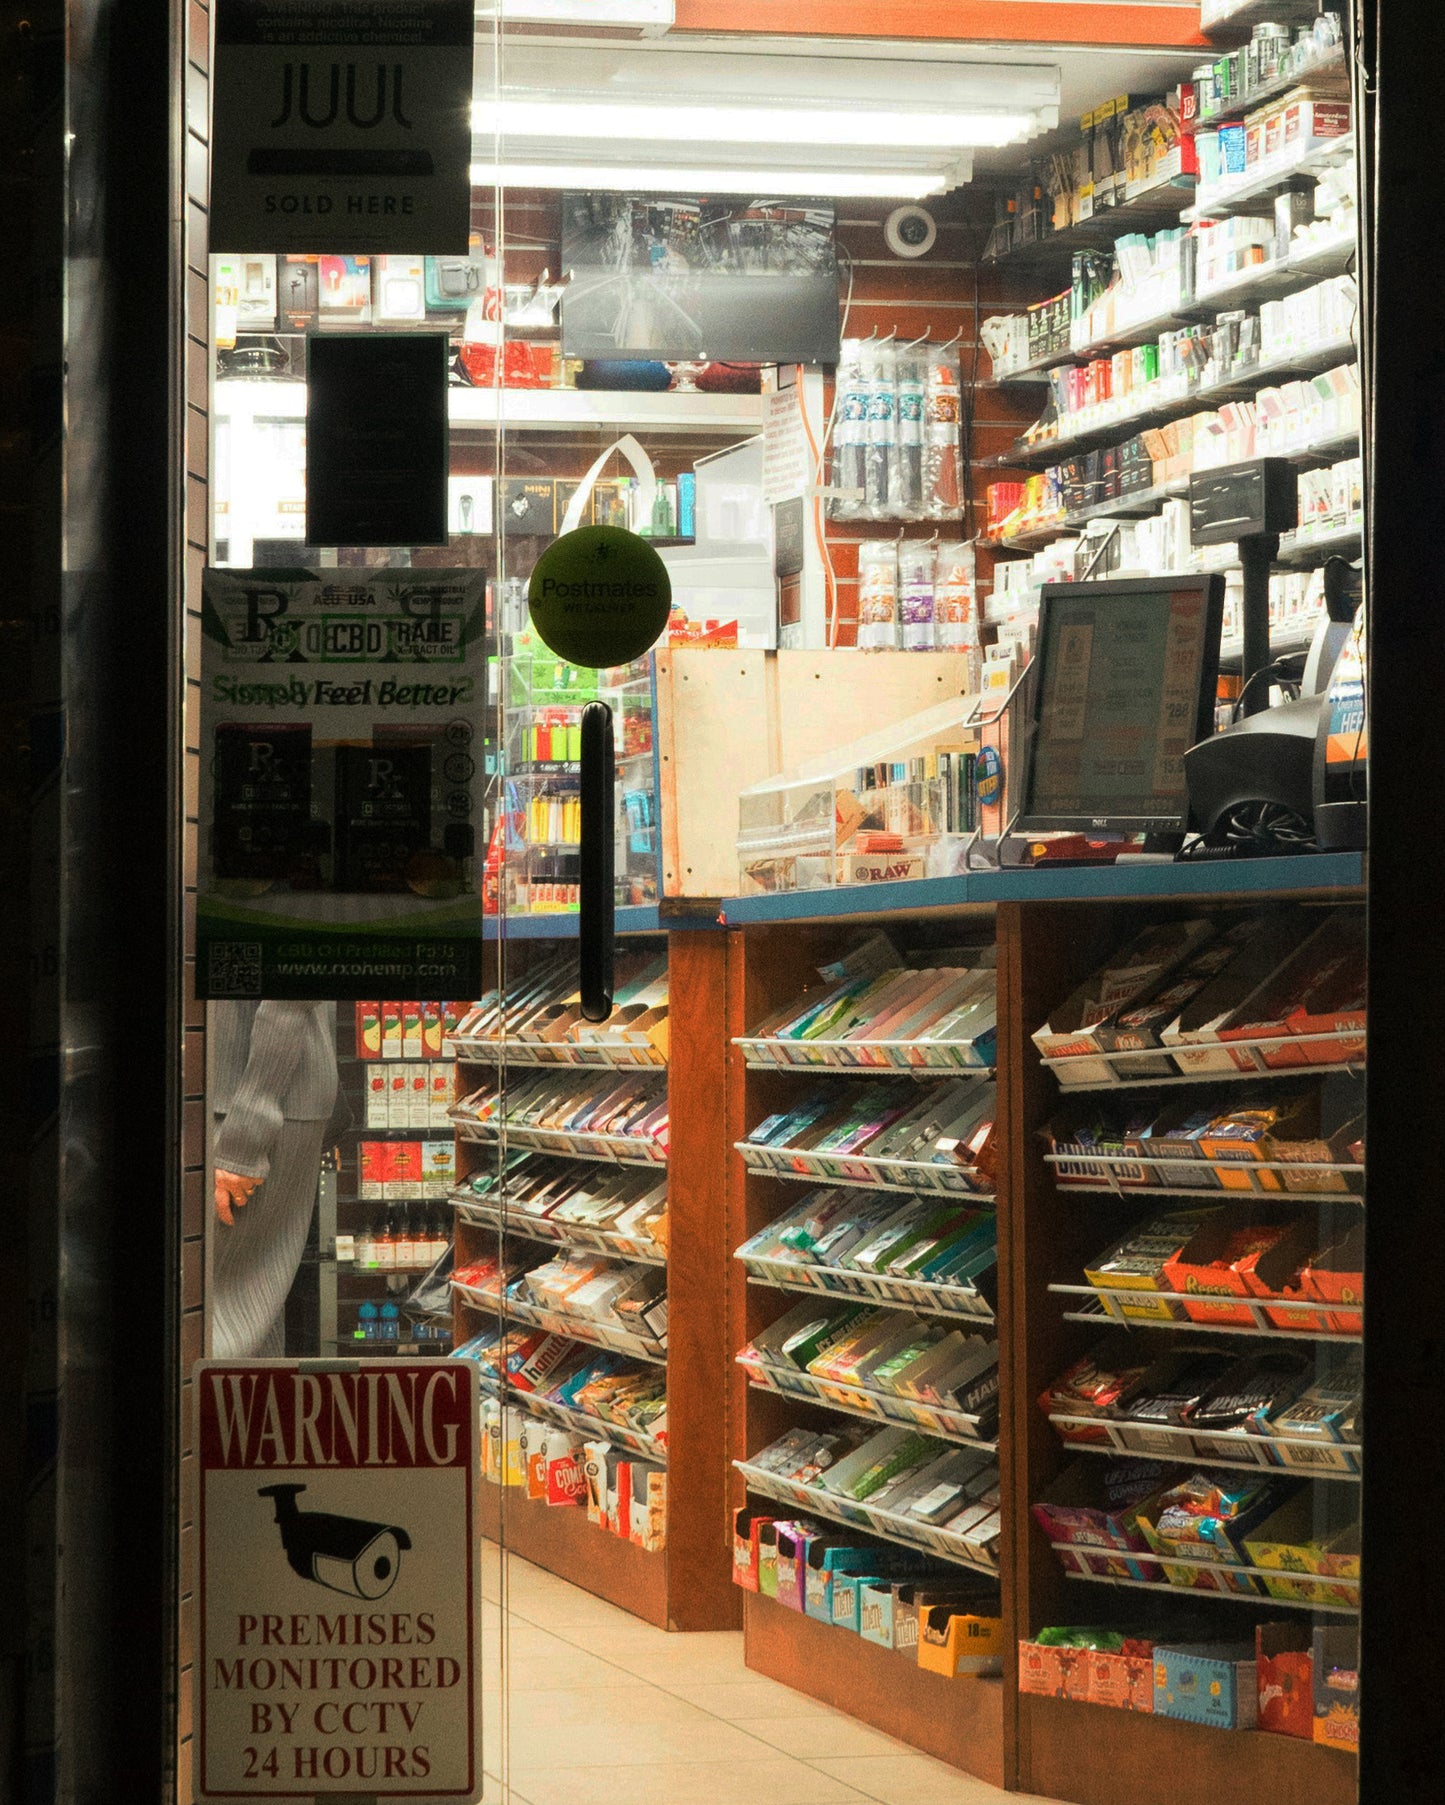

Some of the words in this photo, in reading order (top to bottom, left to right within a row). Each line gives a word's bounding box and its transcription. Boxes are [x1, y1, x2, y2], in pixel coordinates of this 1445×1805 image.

[271, 63, 412, 129] JUUL
[264, 195, 333, 214] SOLD
[347, 196, 415, 215] HERE
[541, 577, 659, 598] Postmates
[333, 623, 382, 654] CBD
[313, 680, 371, 706] Feel
[378, 680, 467, 706] Better
[870, 864, 911, 880] RAW
[211, 1370, 460, 1466] WARNING
[237, 1612, 436, 1647] PREMISES
[213, 1656, 461, 1692] MONITORED
[249, 1702, 300, 1734] BY
[313, 1701, 424, 1734] CCTV
[242, 1747, 280, 1779] 24
[293, 1746, 432, 1779] HOURS
